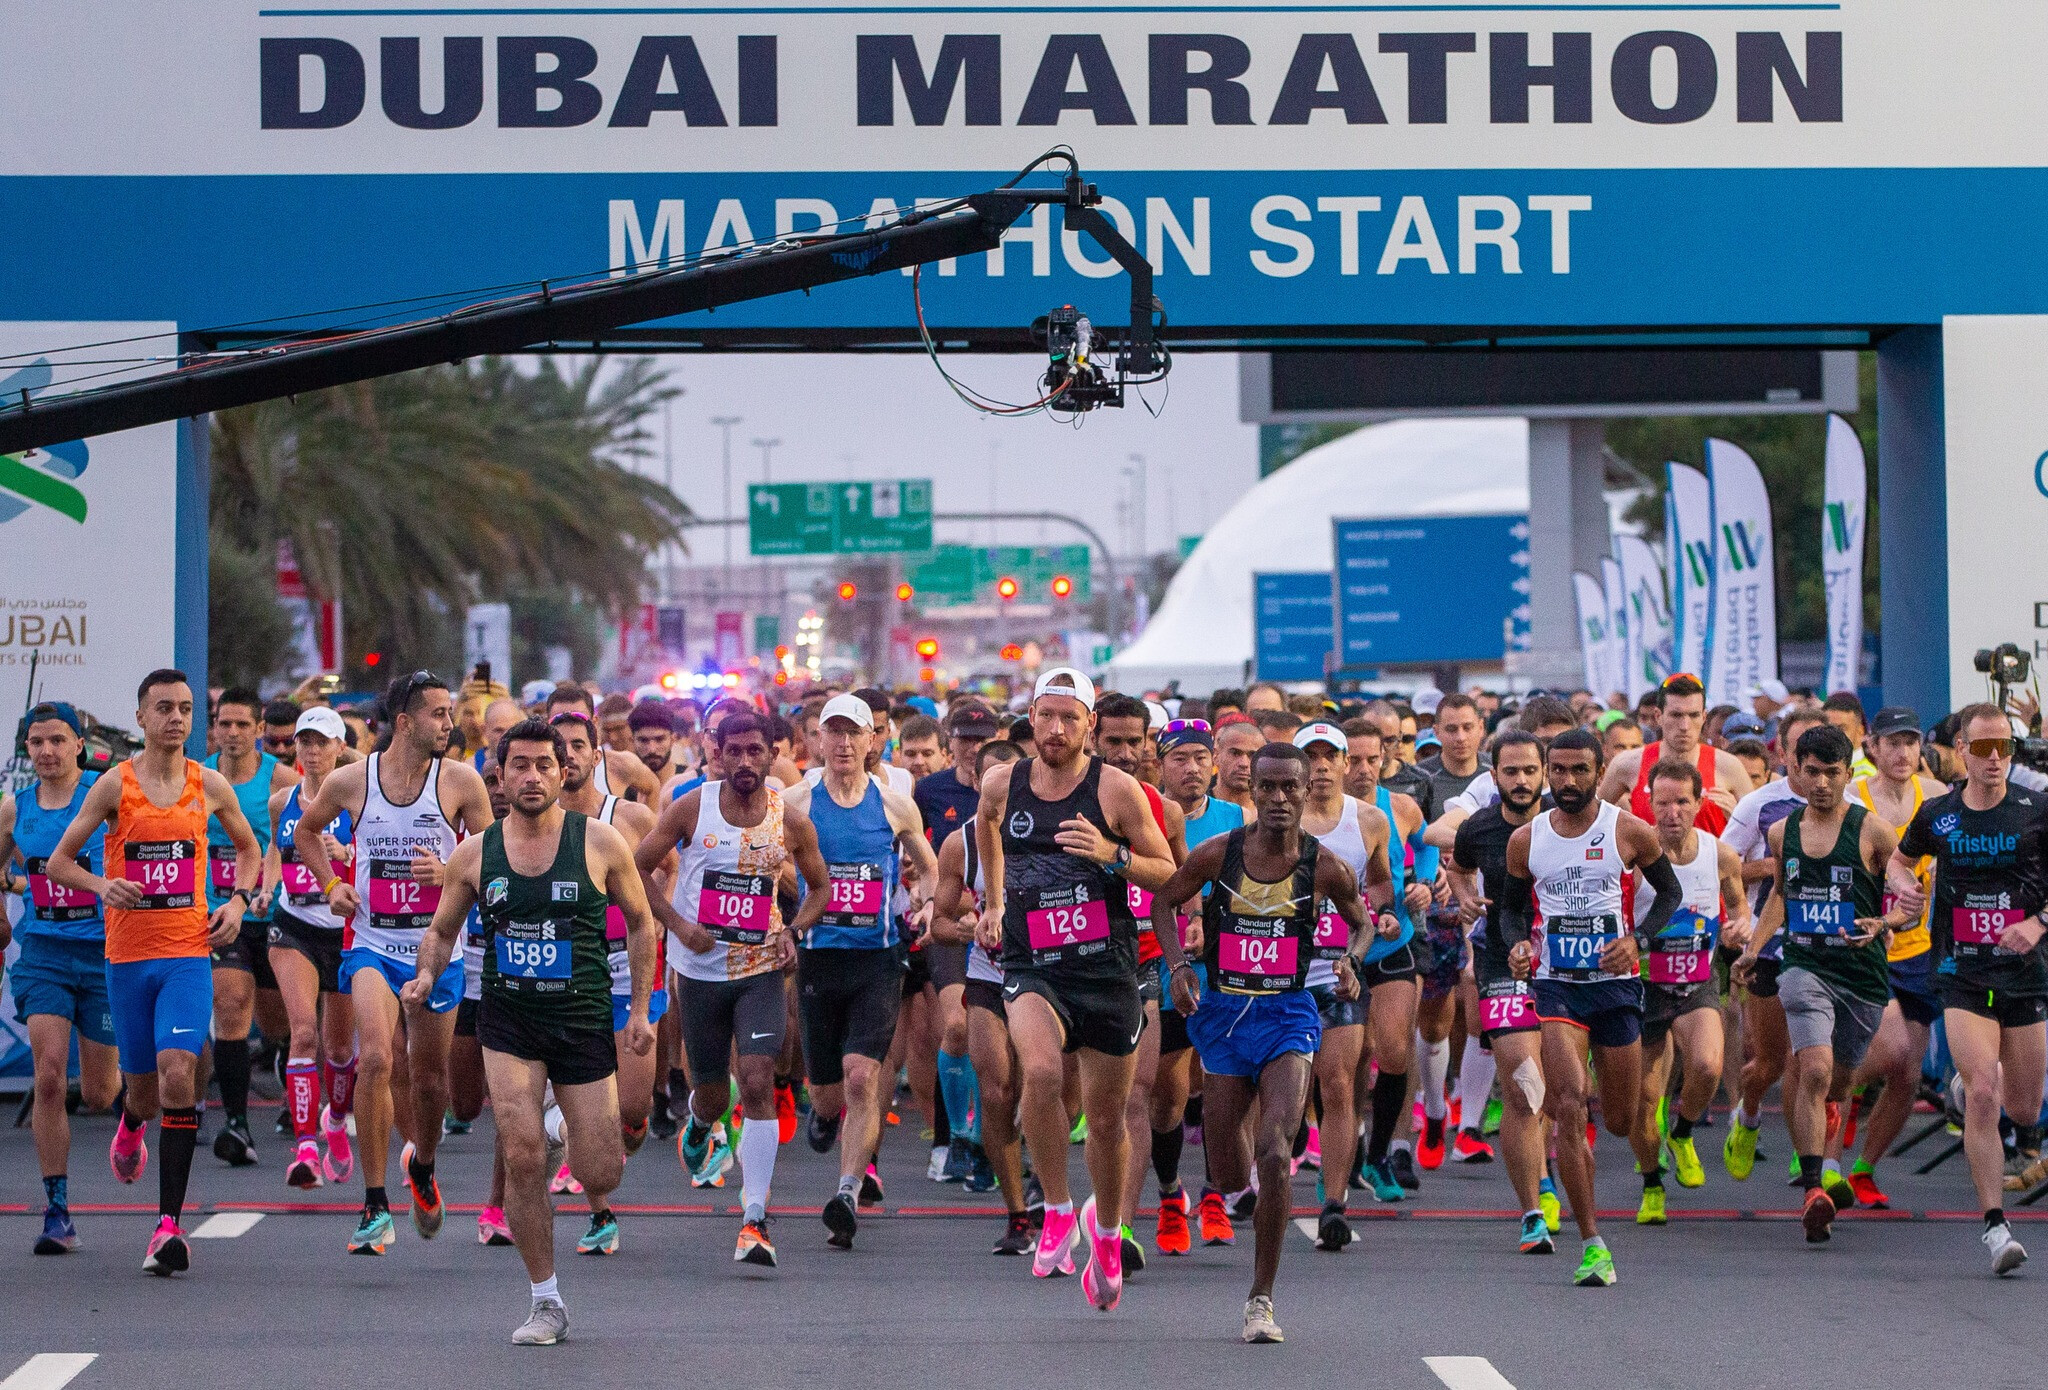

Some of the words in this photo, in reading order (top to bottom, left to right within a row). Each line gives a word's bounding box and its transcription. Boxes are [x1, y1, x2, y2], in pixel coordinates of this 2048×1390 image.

[260, 35, 778, 130] DUBAI
[856, 30, 1843, 127] MARATHON
[1249, 194, 1593, 277] START
[0, 614, 87, 648] UBAI
[1935, 814, 1957, 830] LCC
[139, 844, 170, 852] Standard
[366, 837, 399, 847] SUPER
[402, 836, 442, 846] SPORTS
[1947, 829, 2017, 856] Tristyle
[137, 852, 170, 860] Chartered
[143, 862, 179, 884] 149
[384, 863, 411, 871] Standa
[1566, 866, 1583, 880] THE
[715, 882, 748, 894] Chartered
[719, 875, 750, 886] Standard
[390, 882, 420, 903] 112
[831, 881, 865, 904] 135
[1040, 889, 1073, 900] Standard
[1798, 893, 1828, 901] Chartered
[1801, 885, 1828, 894] Standard
[1966, 893, 1997, 901] Standard
[718, 894, 754, 919] 108
[1039, 897, 1074, 909] Chartered
[1564, 896, 1589, 911] SHOP
[1964, 900, 1997, 909] Chartered
[1046, 906, 1087, 935] 126
[1801, 903, 1840, 924] 1441
[509, 920, 540, 931] Standard
[1238, 917, 1271, 928] Standard
[1558, 925, 1591, 933] Chartered
[1560, 918, 1591, 926] Standard
[1970, 912, 2005, 935] 139
[506, 928, 540, 939] Chartered
[1234, 925, 1271, 936] Chartered
[505, 941, 557, 967] 1589
[1239, 938, 1279, 963] 104
[1557, 936, 1605, 958] 1704
[1666, 954, 1698, 974] 159
[1489, 997, 1525, 1020] 275
[333, 1073, 347, 1104] CZECH
[293, 1075, 309, 1124] CZECH
